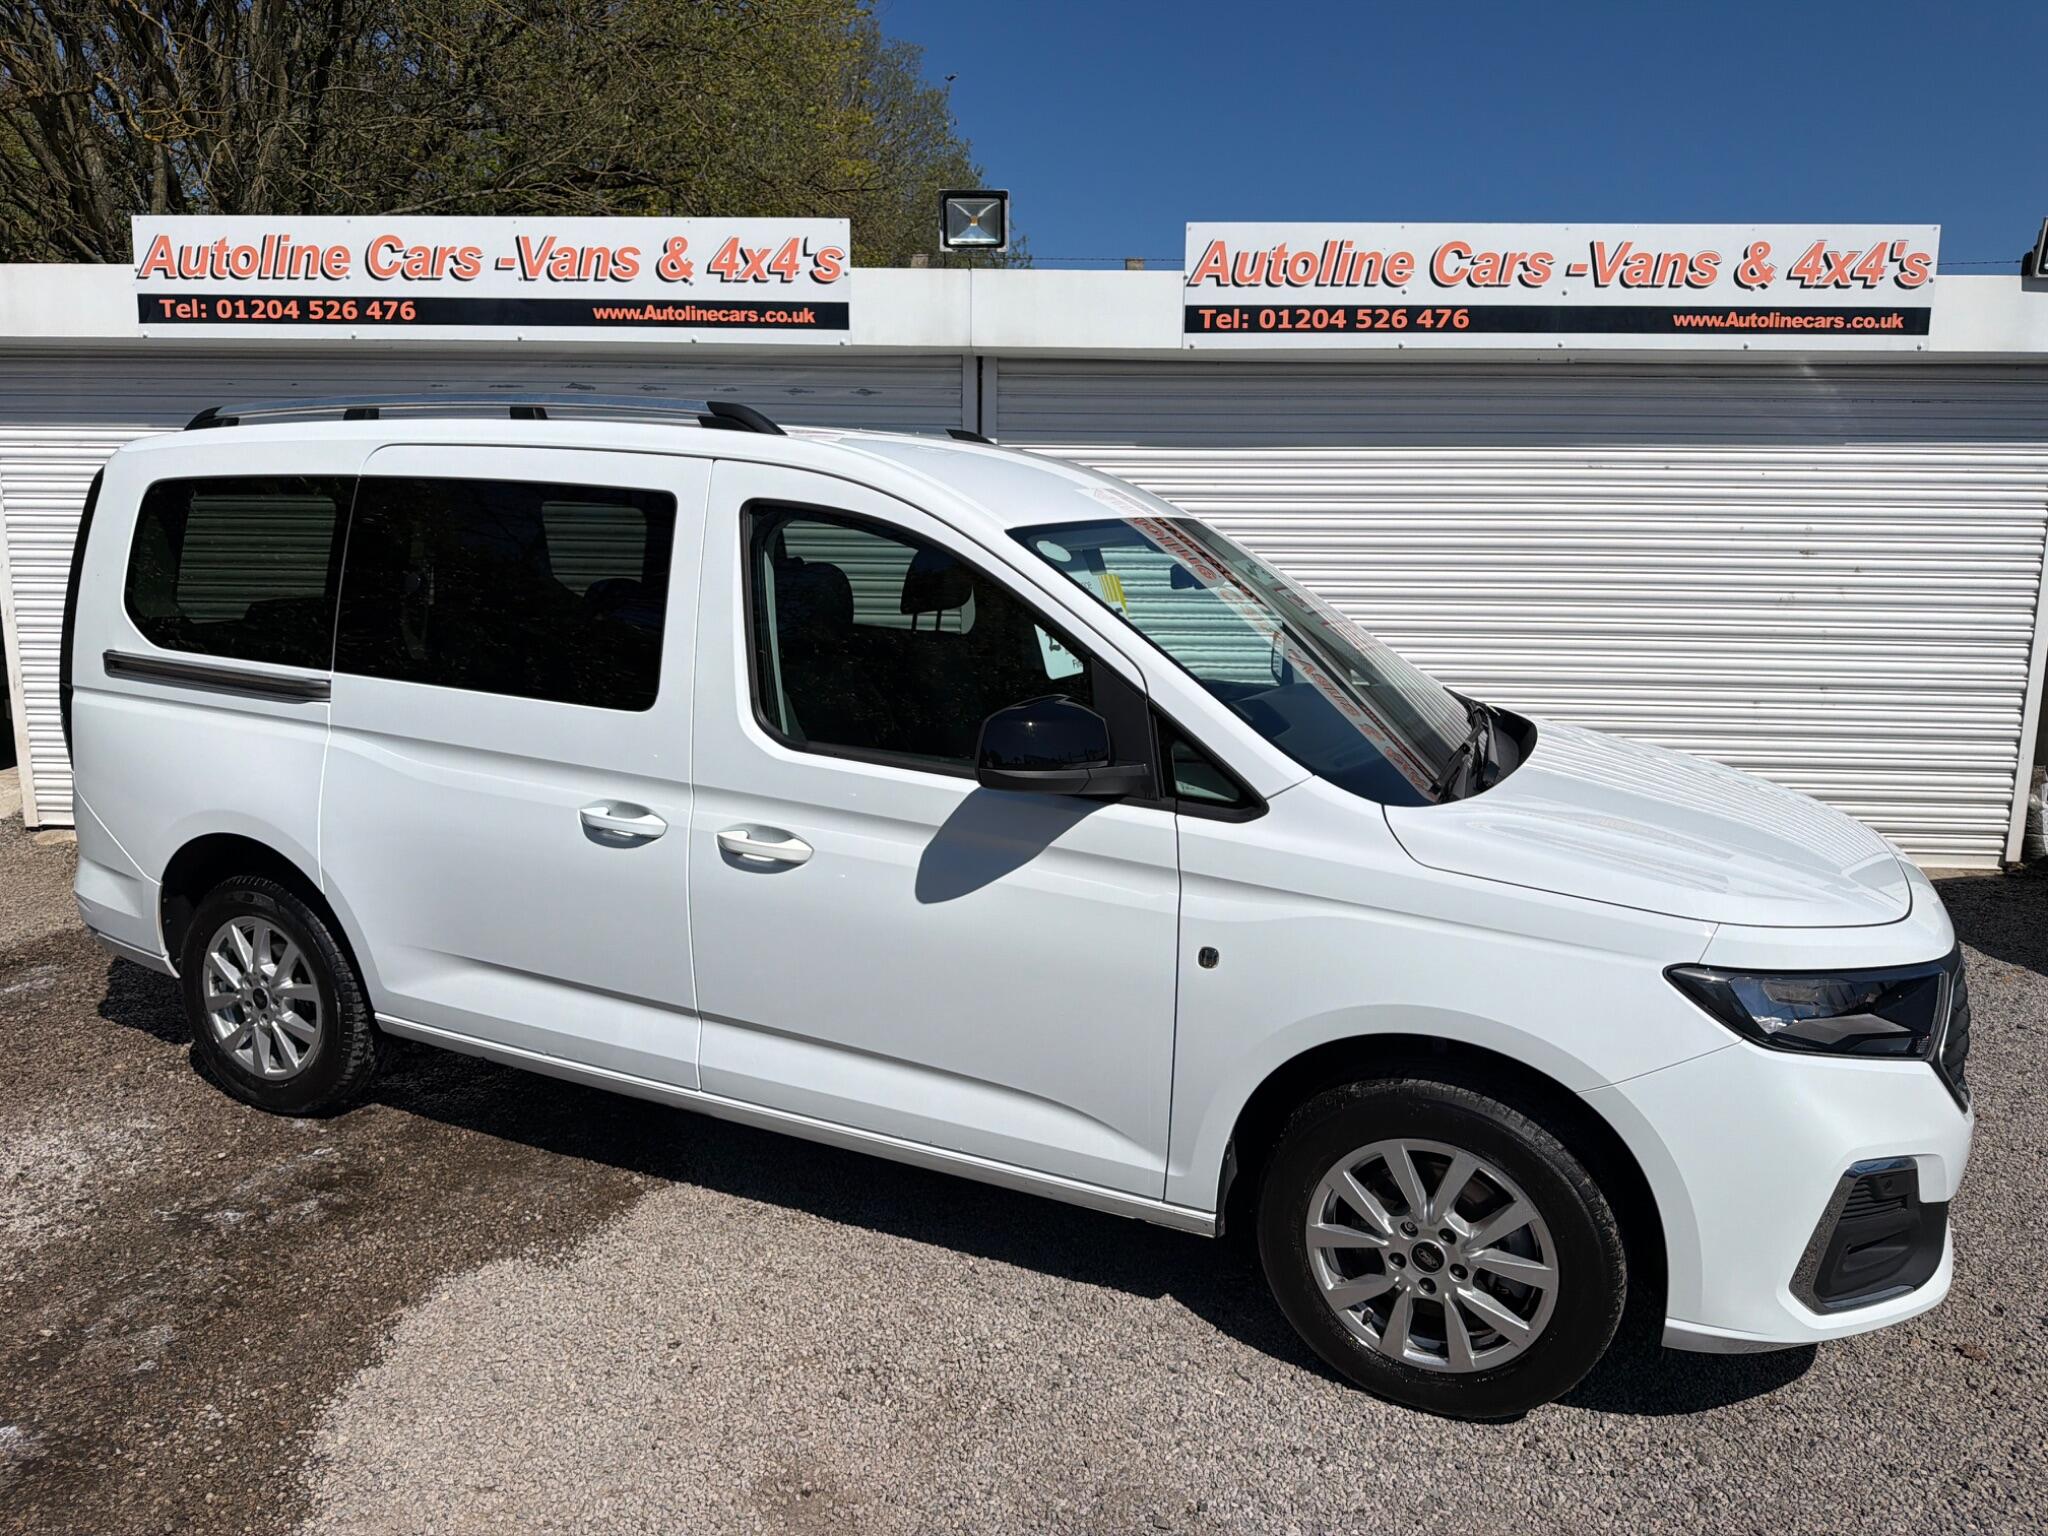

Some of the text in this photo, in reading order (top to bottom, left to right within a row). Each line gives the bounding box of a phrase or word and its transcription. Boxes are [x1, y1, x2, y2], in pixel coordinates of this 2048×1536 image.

[137, 234, 352, 280] Autoline
[365, 234, 484, 281] Cars
[656, 236, 695, 284] &
[707, 236, 846, 284] 4x4's
[1186, 239, 1415, 287] Autoline
[1429, 240, 1554, 288] Cars
[1733, 241, 1776, 289] &
[1786, 239, 1933, 290] 4x4's
[159, 298, 417, 321] Tel: 01204 526 476
[1199, 309, 1470, 329] Tel: 01204 526 476
